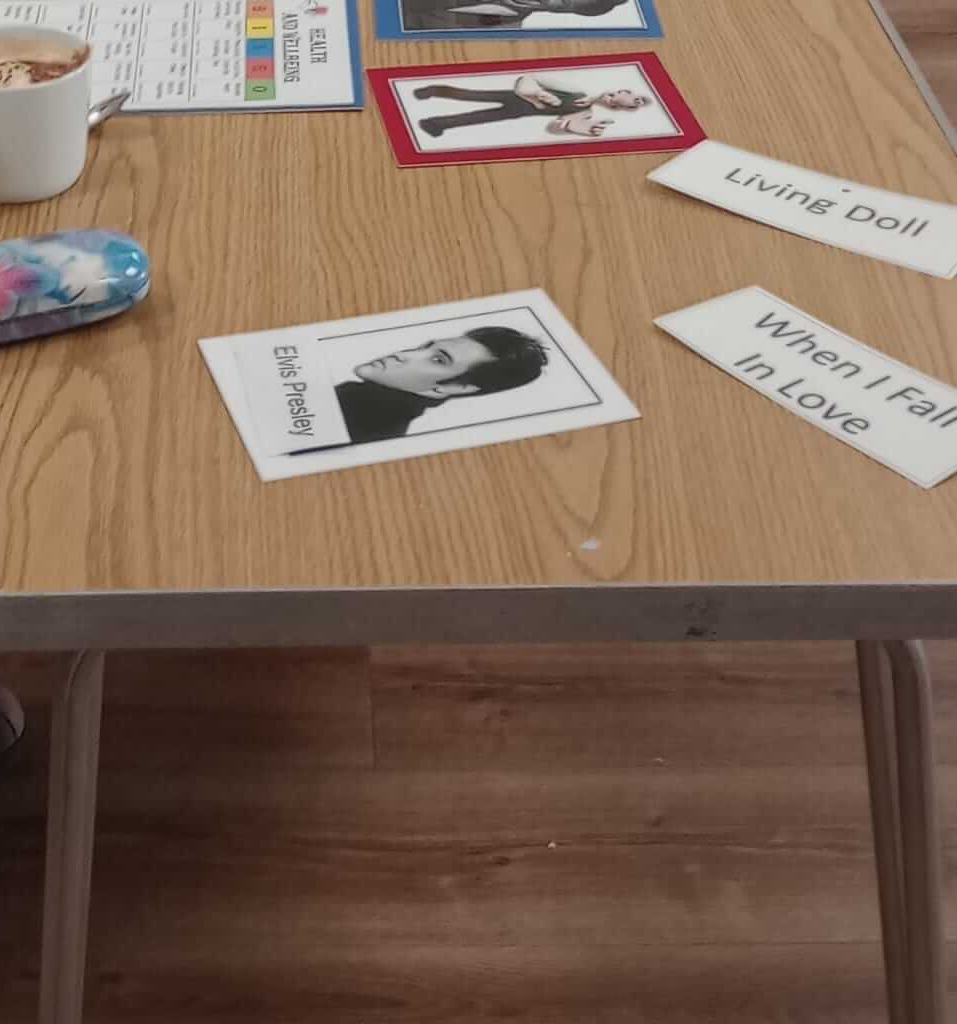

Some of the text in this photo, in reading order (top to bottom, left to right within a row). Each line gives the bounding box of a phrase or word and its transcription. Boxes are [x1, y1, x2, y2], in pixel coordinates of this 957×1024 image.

[282, 12, 301, 83] AND WELLBEING
[309, 28, 328, 64] HEALTH
[724, 167, 929, 237] Living Doll
[273, 345, 316, 436] Elvis Presley
[732, 353, 871, 435] In Love
[754, 311, 957, 428] When I Fall
